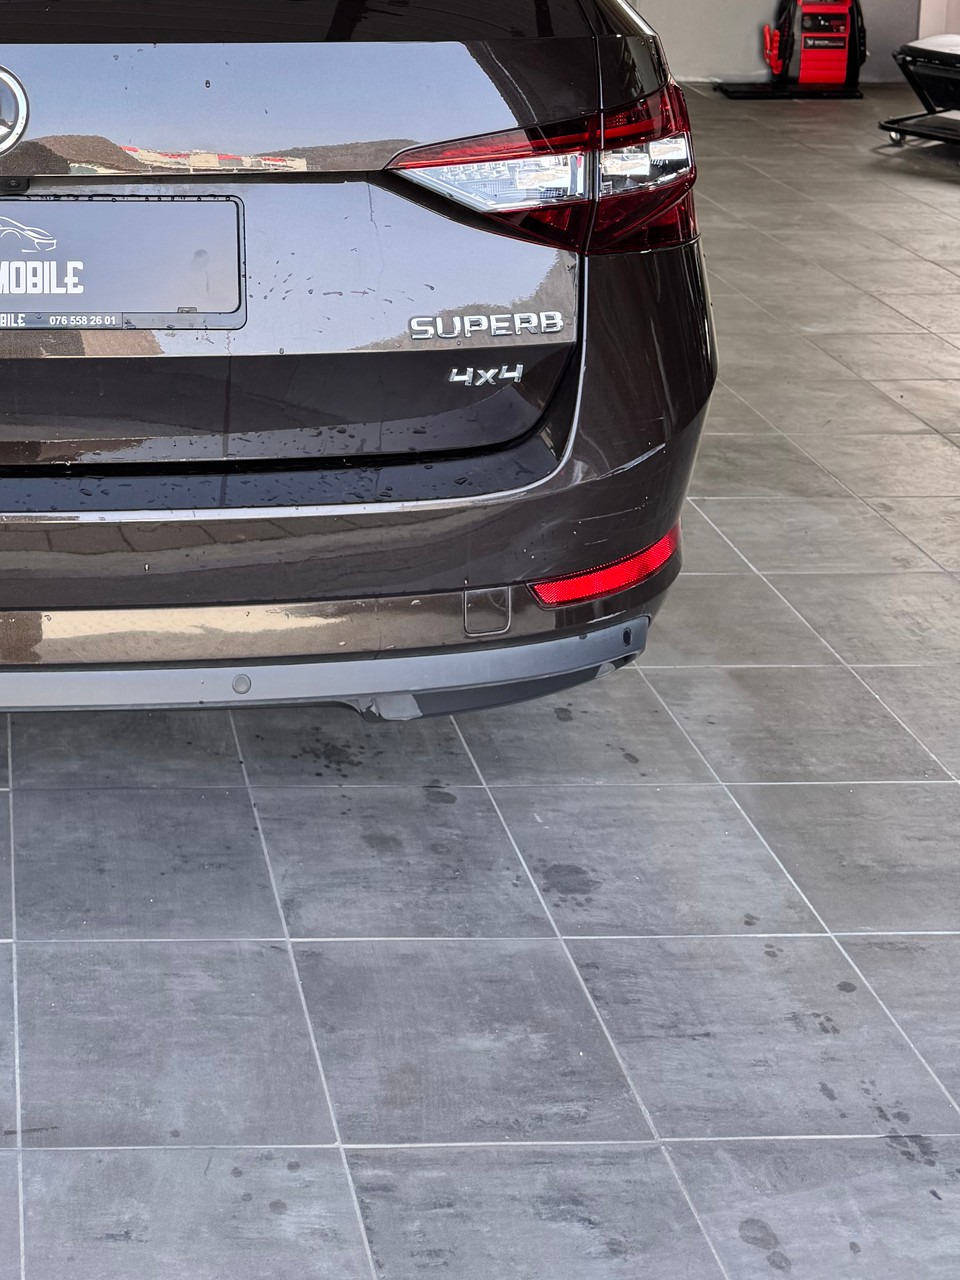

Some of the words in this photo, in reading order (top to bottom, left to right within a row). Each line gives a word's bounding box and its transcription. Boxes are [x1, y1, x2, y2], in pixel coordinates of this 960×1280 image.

[49, 315, 68, 326] 076
[70, 315, 88, 326] 558
[90, 315, 103, 326] 26
[105, 315, 116, 326] 01
[410, 312, 565, 339] SUPERB
